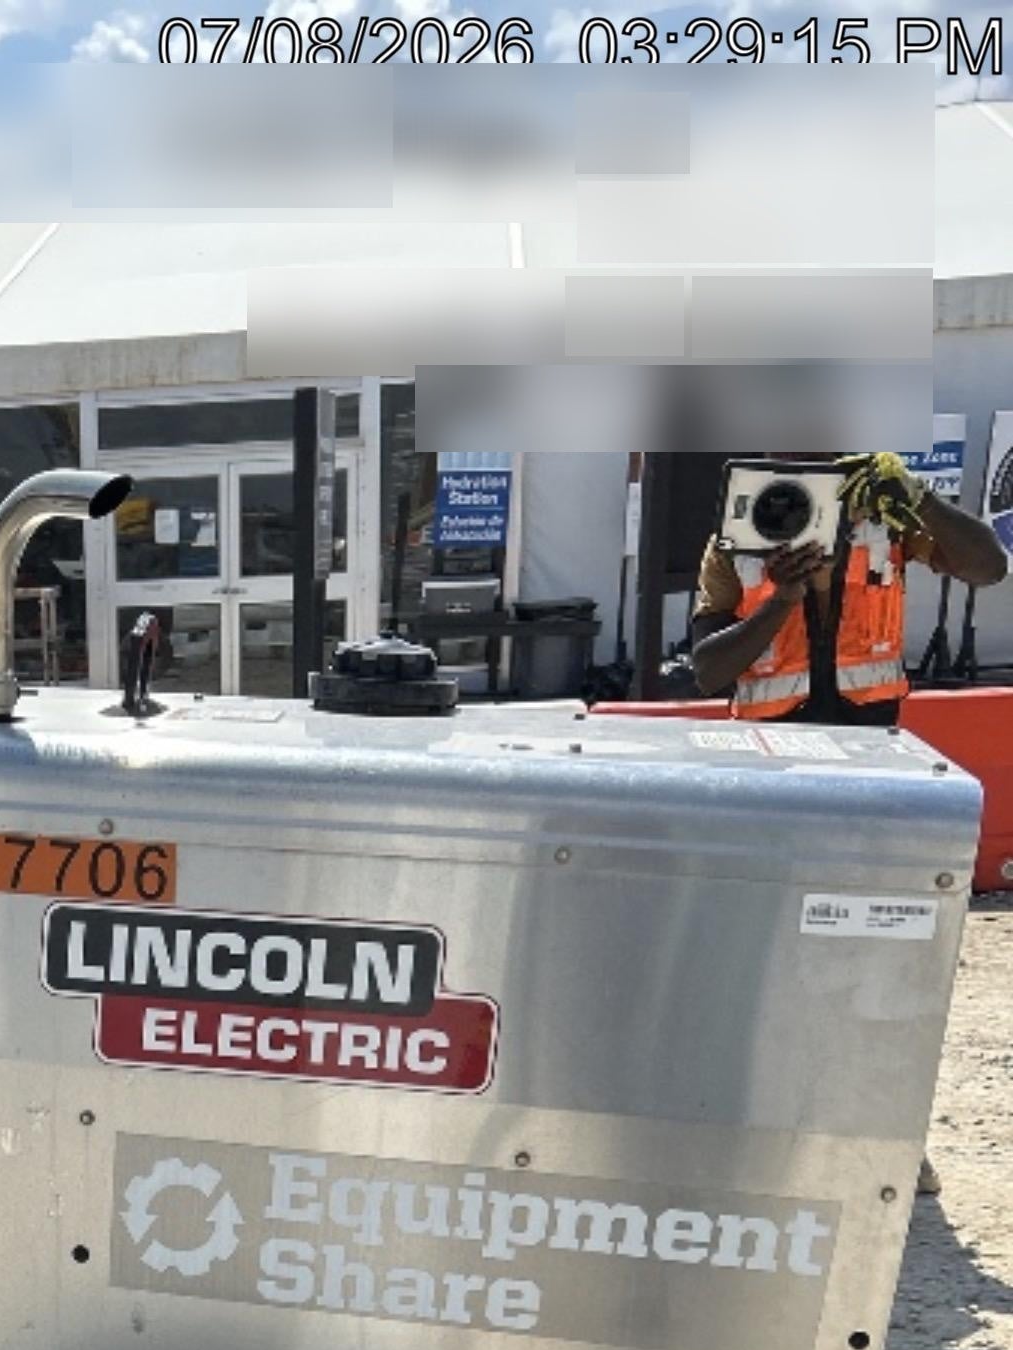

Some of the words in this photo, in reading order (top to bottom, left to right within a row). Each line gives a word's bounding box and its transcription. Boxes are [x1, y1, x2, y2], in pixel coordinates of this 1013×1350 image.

[66, 920, 415, 1005] LINCOLN
[141, 1007, 450, 1075] ELECTRIC
[264, 1153, 832, 1277] Equipment
[257, 1238, 543, 1331] Share
